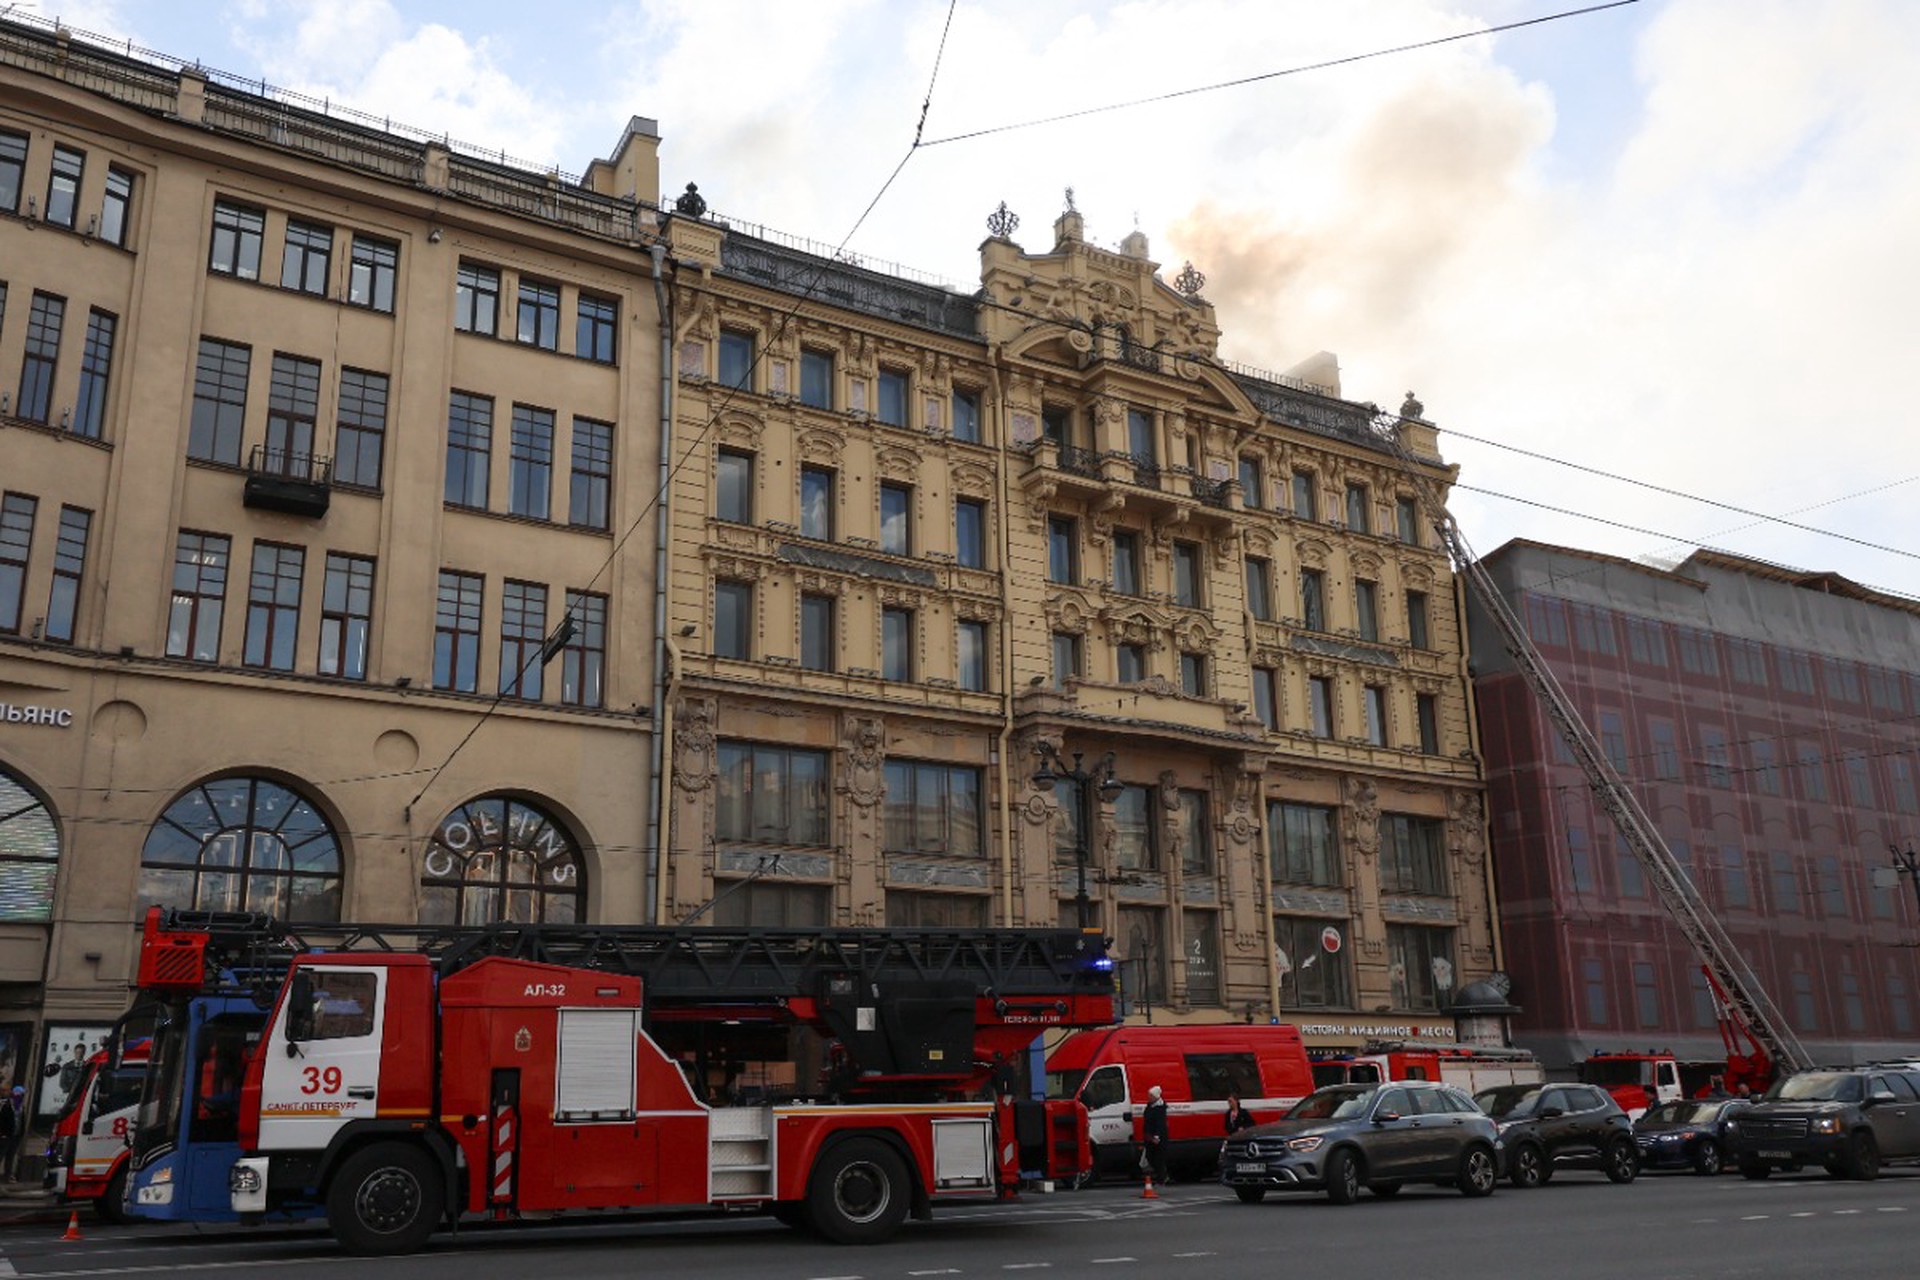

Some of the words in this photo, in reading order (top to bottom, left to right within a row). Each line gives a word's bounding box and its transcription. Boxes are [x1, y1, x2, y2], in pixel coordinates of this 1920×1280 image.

[1193, 939, 1201, 955] 2
[524, 984, 566, 997] АЛ-32
[1302, 1024, 1345, 1035] РЕСТОРАН
[1420, 1026, 1454, 1037] МЕСТО
[300, 1066, 342, 1095] 39
[266, 1102, 359, 1111] САНКТ-ПЕТЕРБУРГ
[112, 1116, 129, 1136] 8
